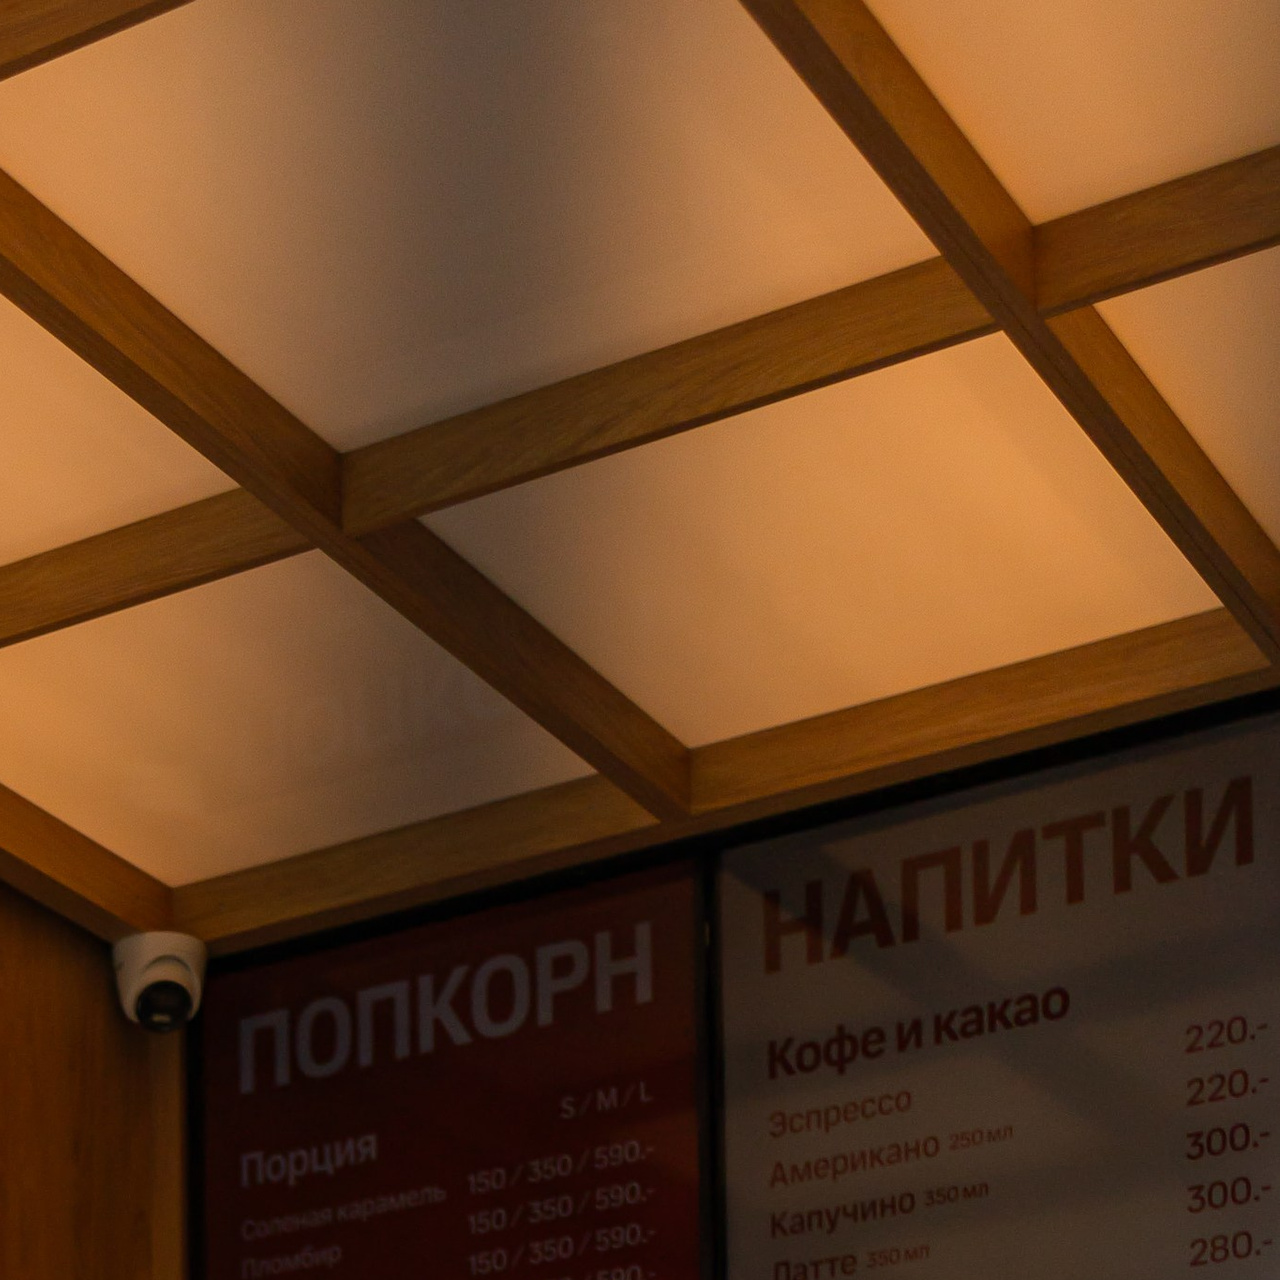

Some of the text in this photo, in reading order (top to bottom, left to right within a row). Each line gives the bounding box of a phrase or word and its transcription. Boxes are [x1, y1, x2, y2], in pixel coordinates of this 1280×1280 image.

[764, 776, 1255, 974] НАПИТКИ
[238, 920, 653, 1095] ПОПКОРН
[768, 987, 1070, 1079] Кофе и какао
[1186, 1016, 1267, 1053] 220.-
[1187, 1069, 1268, 1106] 220.-
[769, 1091, 911, 1138] Эспрессо
[241, 1134, 377, 1187] Порция
[1186, 1123, 1270, 1160] 300.-
[468, 1168, 506, 1193] 150
[528, 1154, 572, 1182] 350
[770, 1136, 940, 1187] Американо
[337, 1186, 446, 1221] карамель
[468, 1208, 507, 1234] 150
[529, 1195, 573, 1223] 350
[1188, 1177, 1271, 1213] 300.-
[771, 1192, 916, 1238] Капучино
[242, 1245, 342, 1279] Пломбир
[469, 1248, 507, 1274] 150
[529, 1236, 574, 1264] 350
[1190, 1231, 1272, 1266] 280.-
